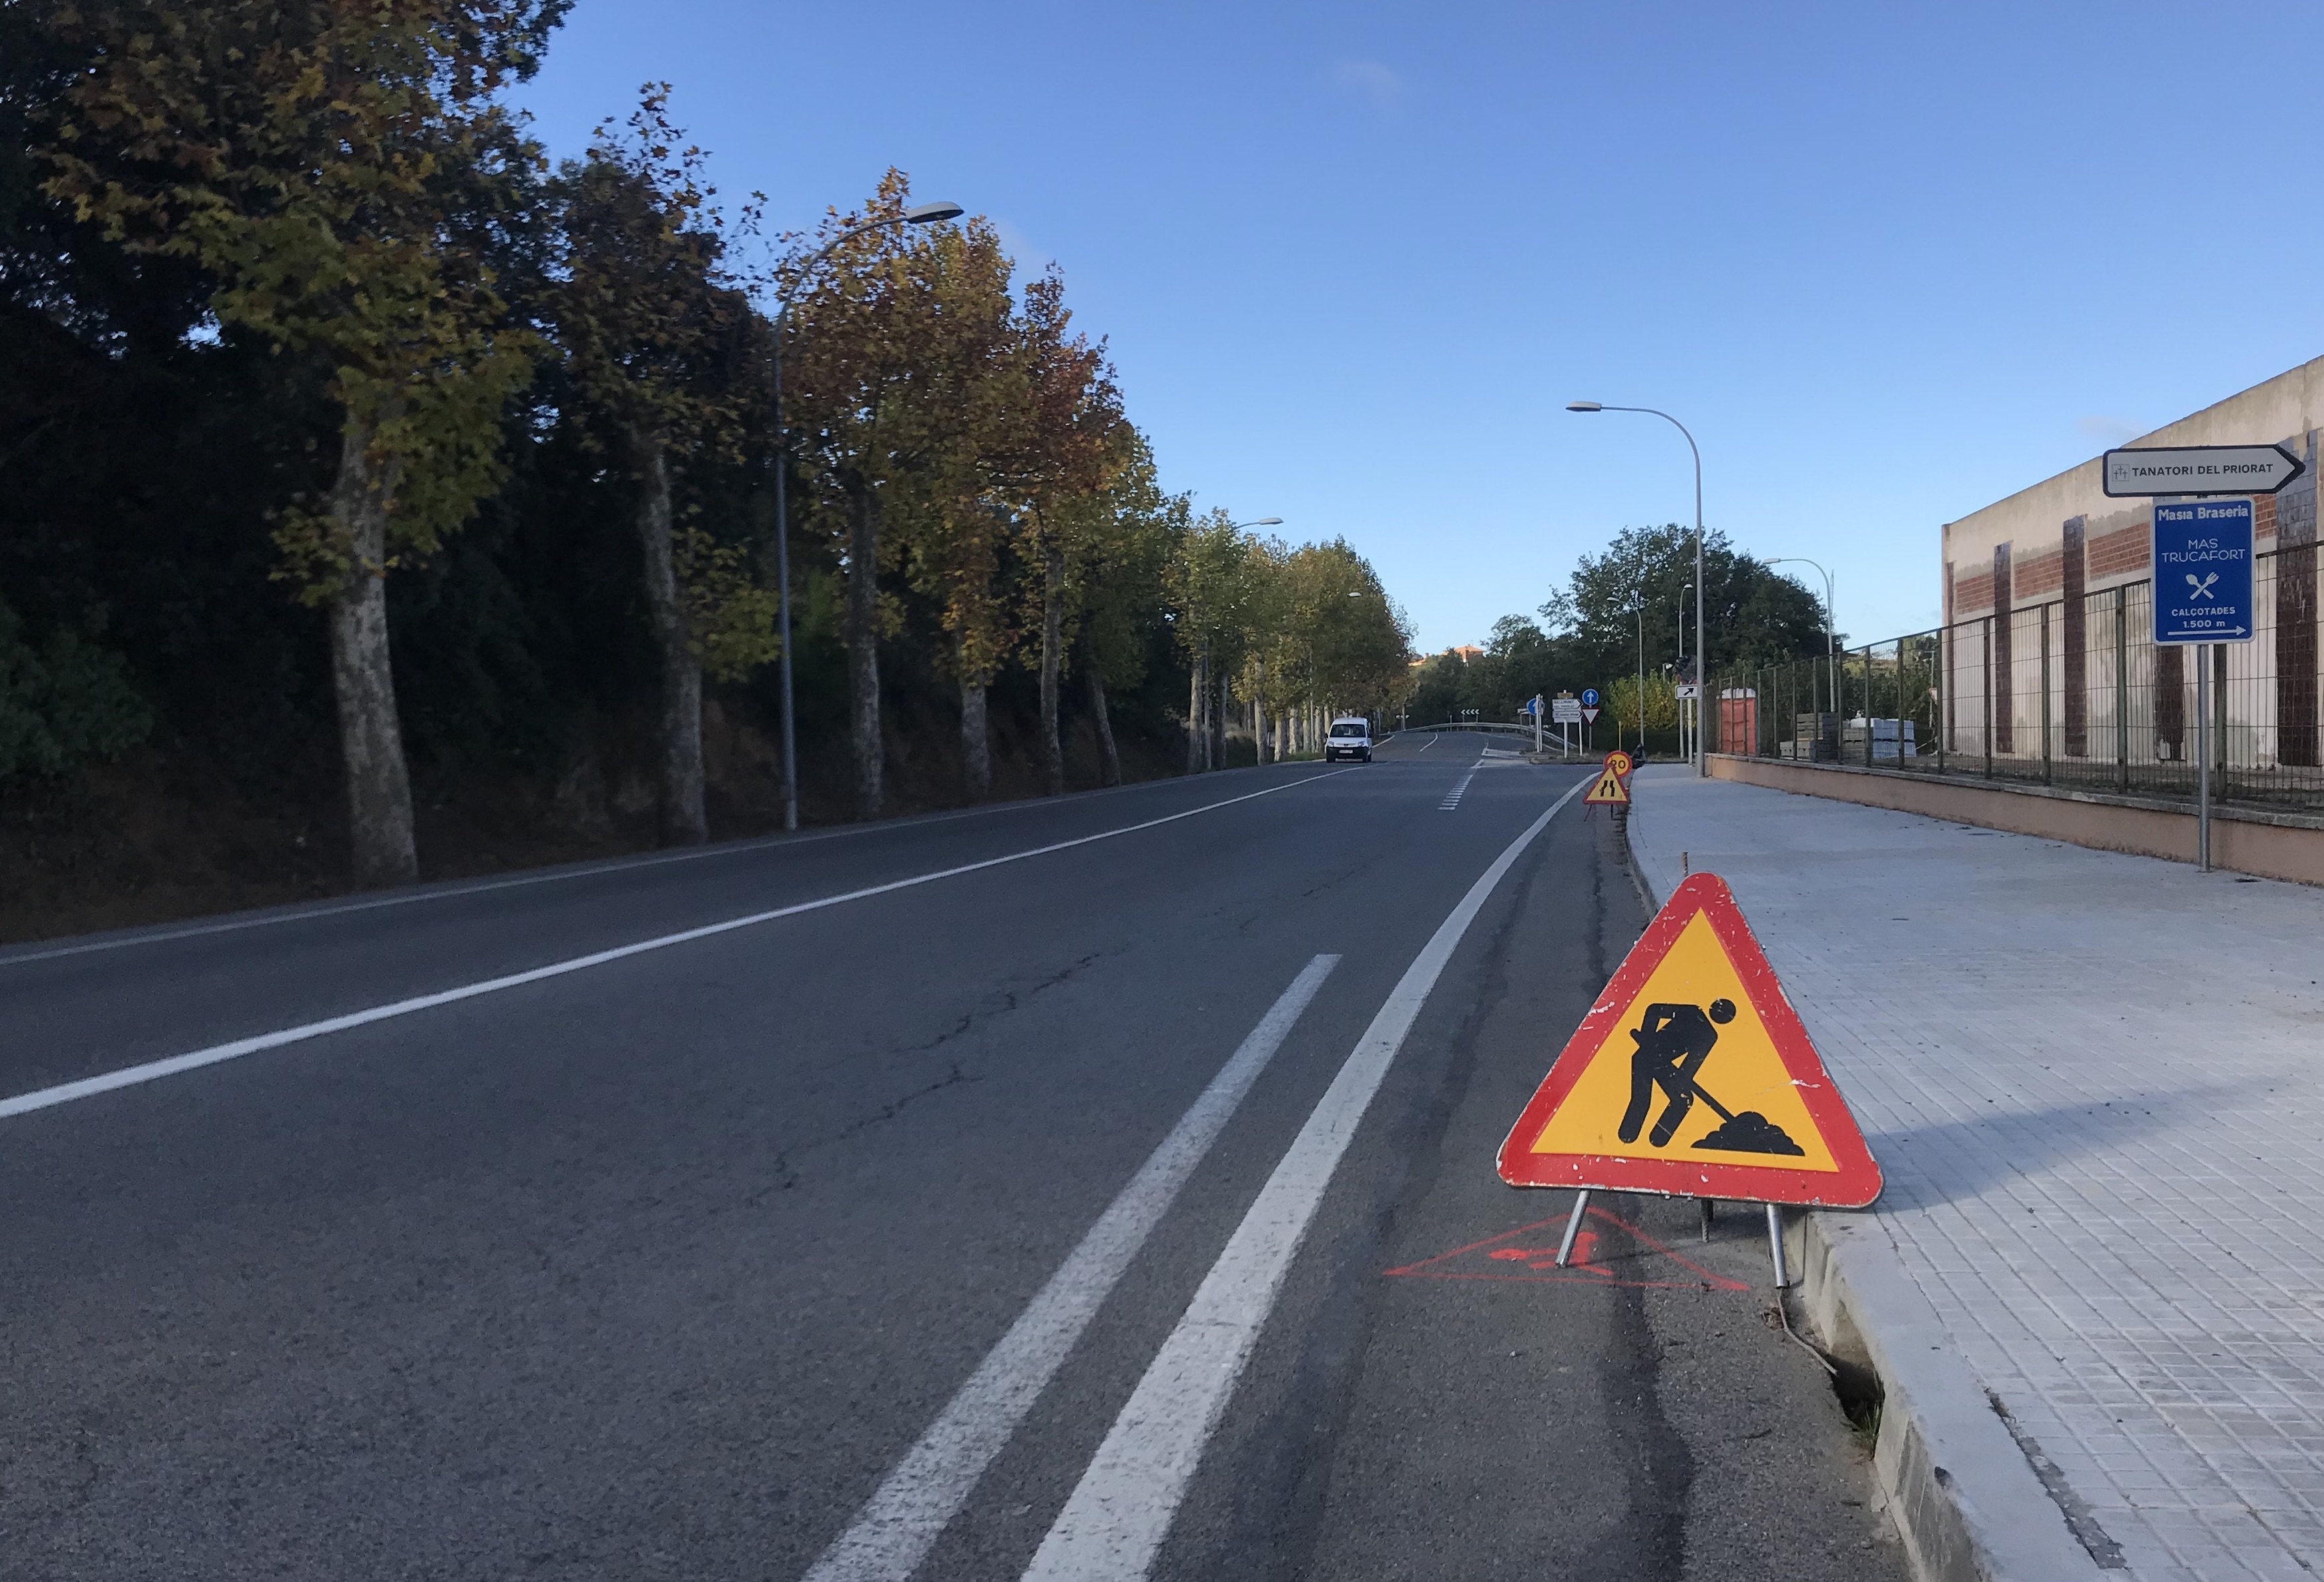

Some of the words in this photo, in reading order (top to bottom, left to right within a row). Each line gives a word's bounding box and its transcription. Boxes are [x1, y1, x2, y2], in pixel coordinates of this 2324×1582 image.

[2132, 466, 2193, 476] TANATORI
[2197, 465, 2221, 475] DEL
[2223, 464, 2273, 474] PRIORAT
[2158, 508, 2194, 521] Masia
[2197, 504, 2249, 520] Braseria
[2188, 538, 2219, 549] MAS
[2161, 548, 2246, 563] TRUCAFORT
[2171, 607, 2236, 617] CALÇOTADES
[2183, 620, 2212, 629] 1.500
[1609, 759, 1626, 769] 20
